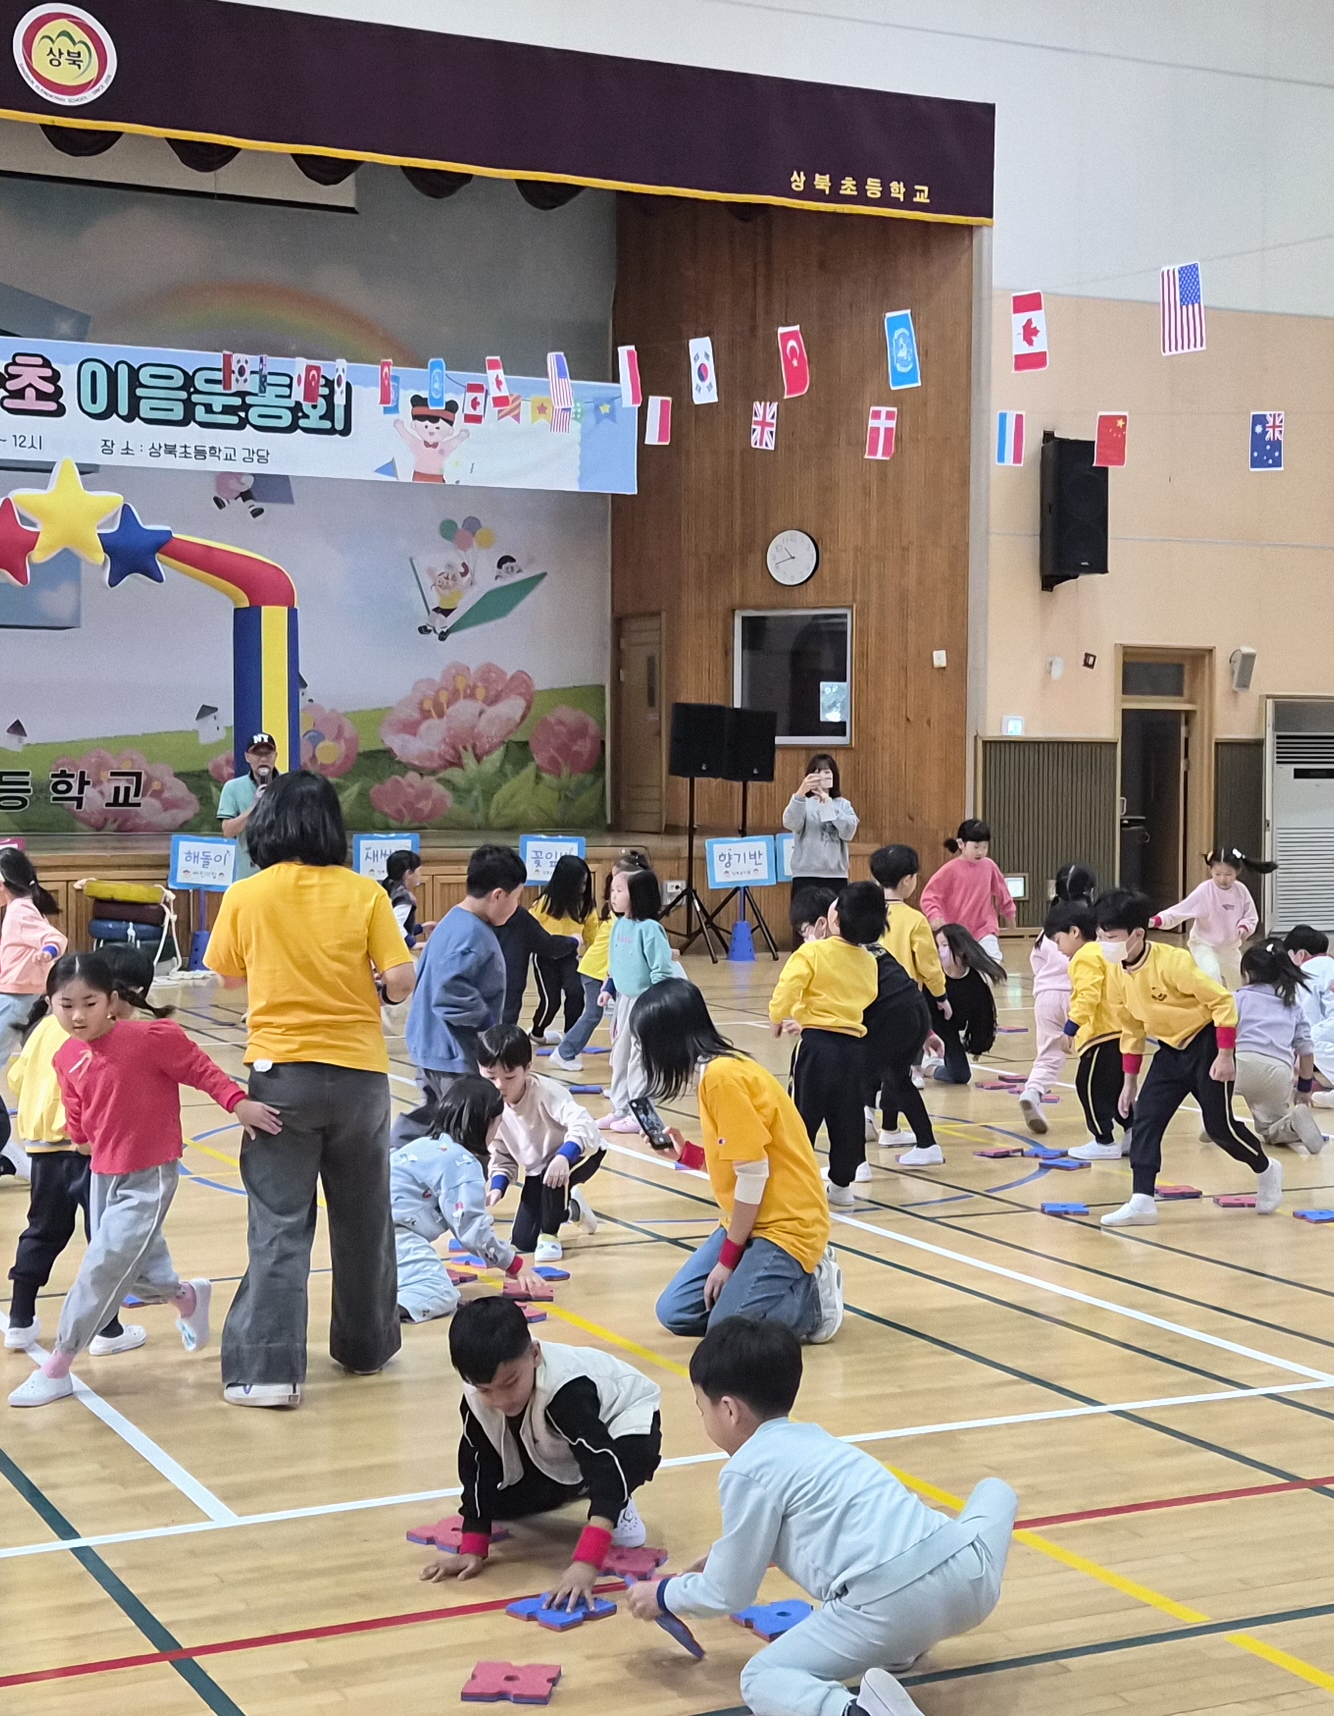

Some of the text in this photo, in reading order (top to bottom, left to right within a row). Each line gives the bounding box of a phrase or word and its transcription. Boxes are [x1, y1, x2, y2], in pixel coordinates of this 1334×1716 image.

[46, 47, 84, 70] 상북
[790, 170, 931, 204] 상북초등학교
[76, 357, 353, 438] 이음운동회
[12, 434, 43, 451] 12시
[100, 439, 115, 456] 장
[120, 441, 135, 456] 소
[148, 442, 237, 462] 상북초등학교
[241, 447, 271, 464] 강당
[184, 850, 229, 868] 해돌이
[530, 849, 572, 869] 꽃잎
[718, 848, 764, 869] 향기반
